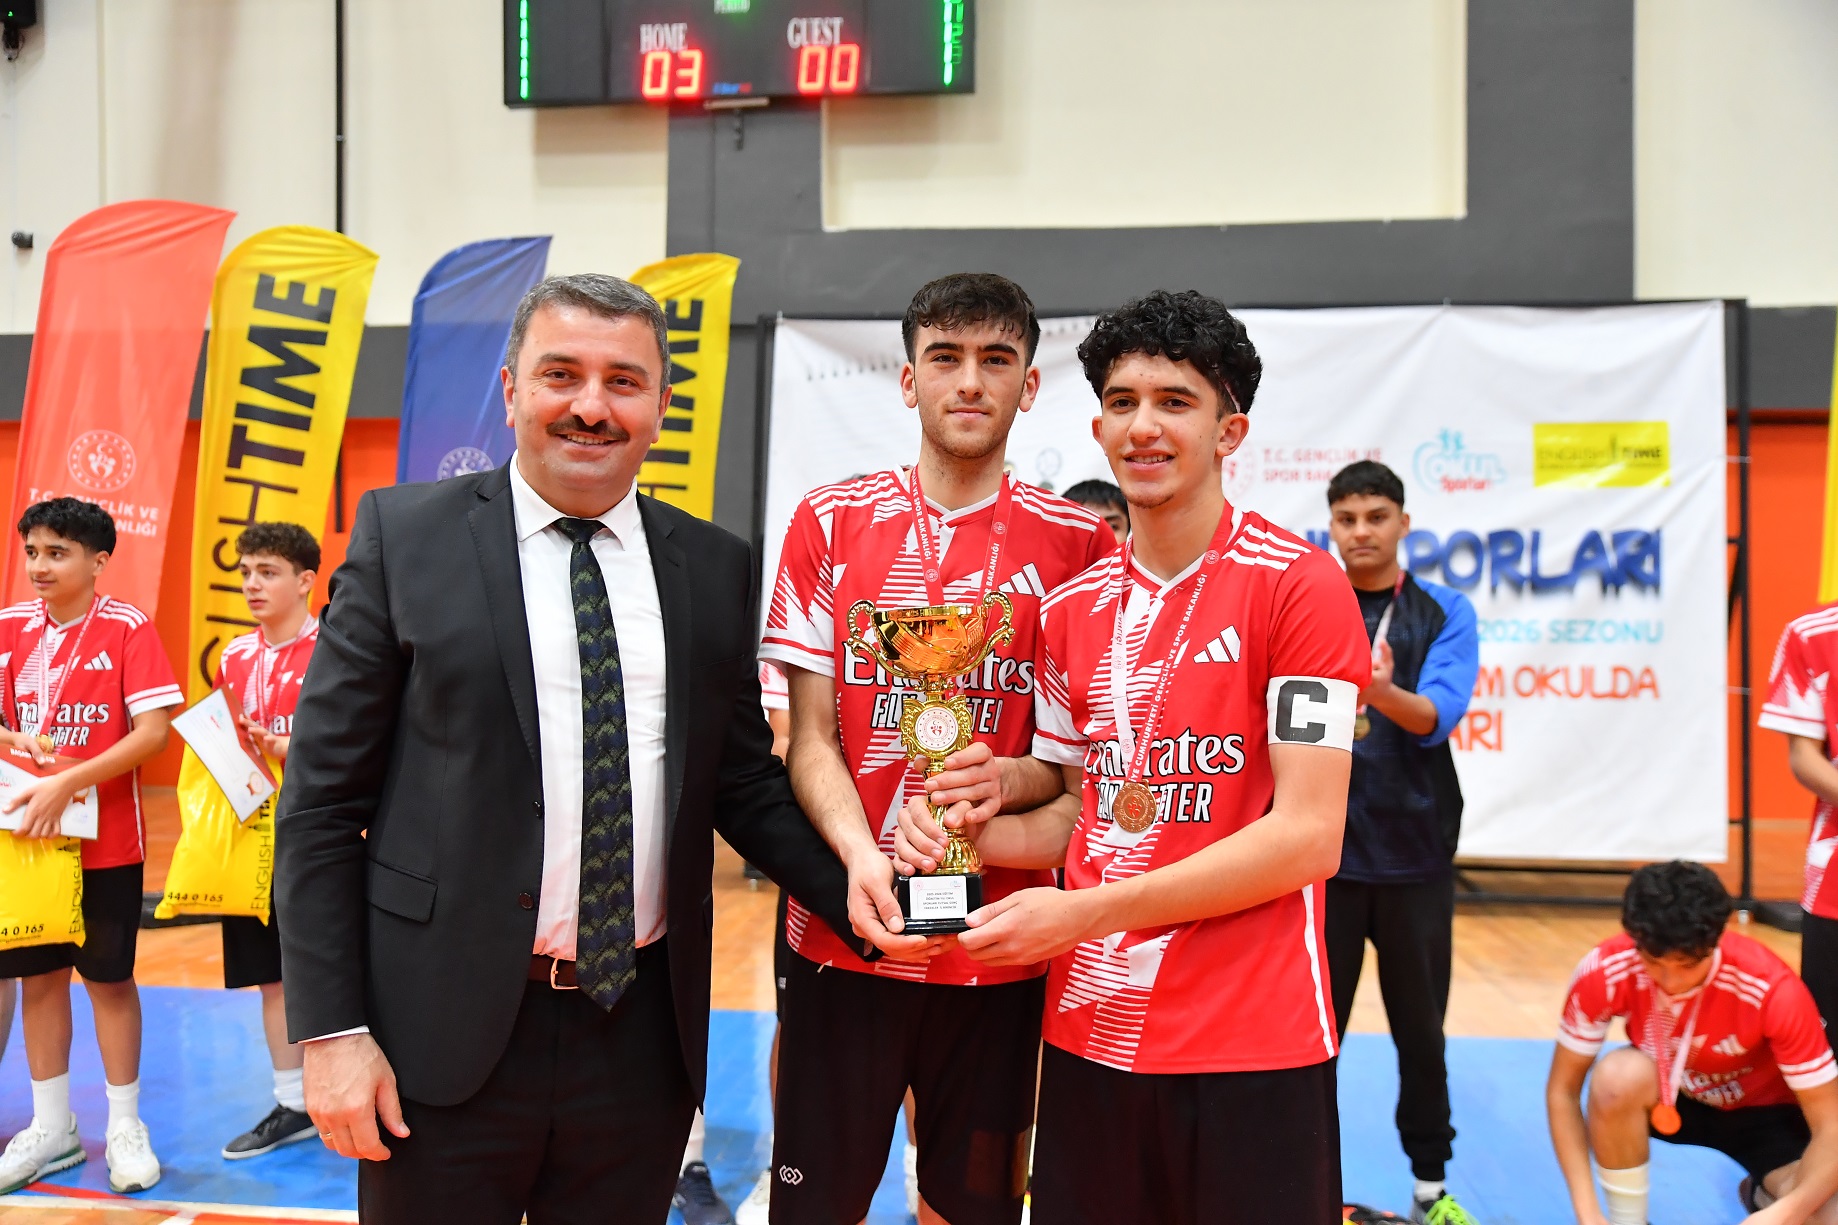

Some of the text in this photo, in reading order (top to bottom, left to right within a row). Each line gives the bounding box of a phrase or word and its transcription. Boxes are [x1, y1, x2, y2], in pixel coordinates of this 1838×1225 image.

[640, 23, 688, 53] HOME
[787, 17, 844, 48] GUEST
[641, 50, 703, 98] 03
[797, 44, 860, 92] 00
[139, 506, 159, 520] VE
[913, 497, 922, 517] SPOR
[918, 518, 932, 560] BAKANLIĞI
[986, 543, 1000, 586] BAKANLIĞI
[1405, 526, 1661, 595] PORLARI
[1549, 618, 1664, 643] SEZONU
[842, 641, 1035, 696] Emates
[1135, 704, 1159, 767] CUMHURİYETİ
[1154, 662, 1172, 702] GENÇLİK
[1167, 649, 1177, 660] VE
[1173, 624, 1187, 647] SPOR
[1183, 573, 1208, 622] BAKANLIĞI
[1513, 664, 1661, 699] OKULDA
[16, 701, 110, 724] mates
[1275, 680, 1328, 744] C
[50, 726, 90, 746] TTER
[251, 835, 271, 910] ENGLISH
[167, 892, 224, 903] 444 0 165
[13, 926, 20, 936] 0
[25, 923, 45, 934] 165
